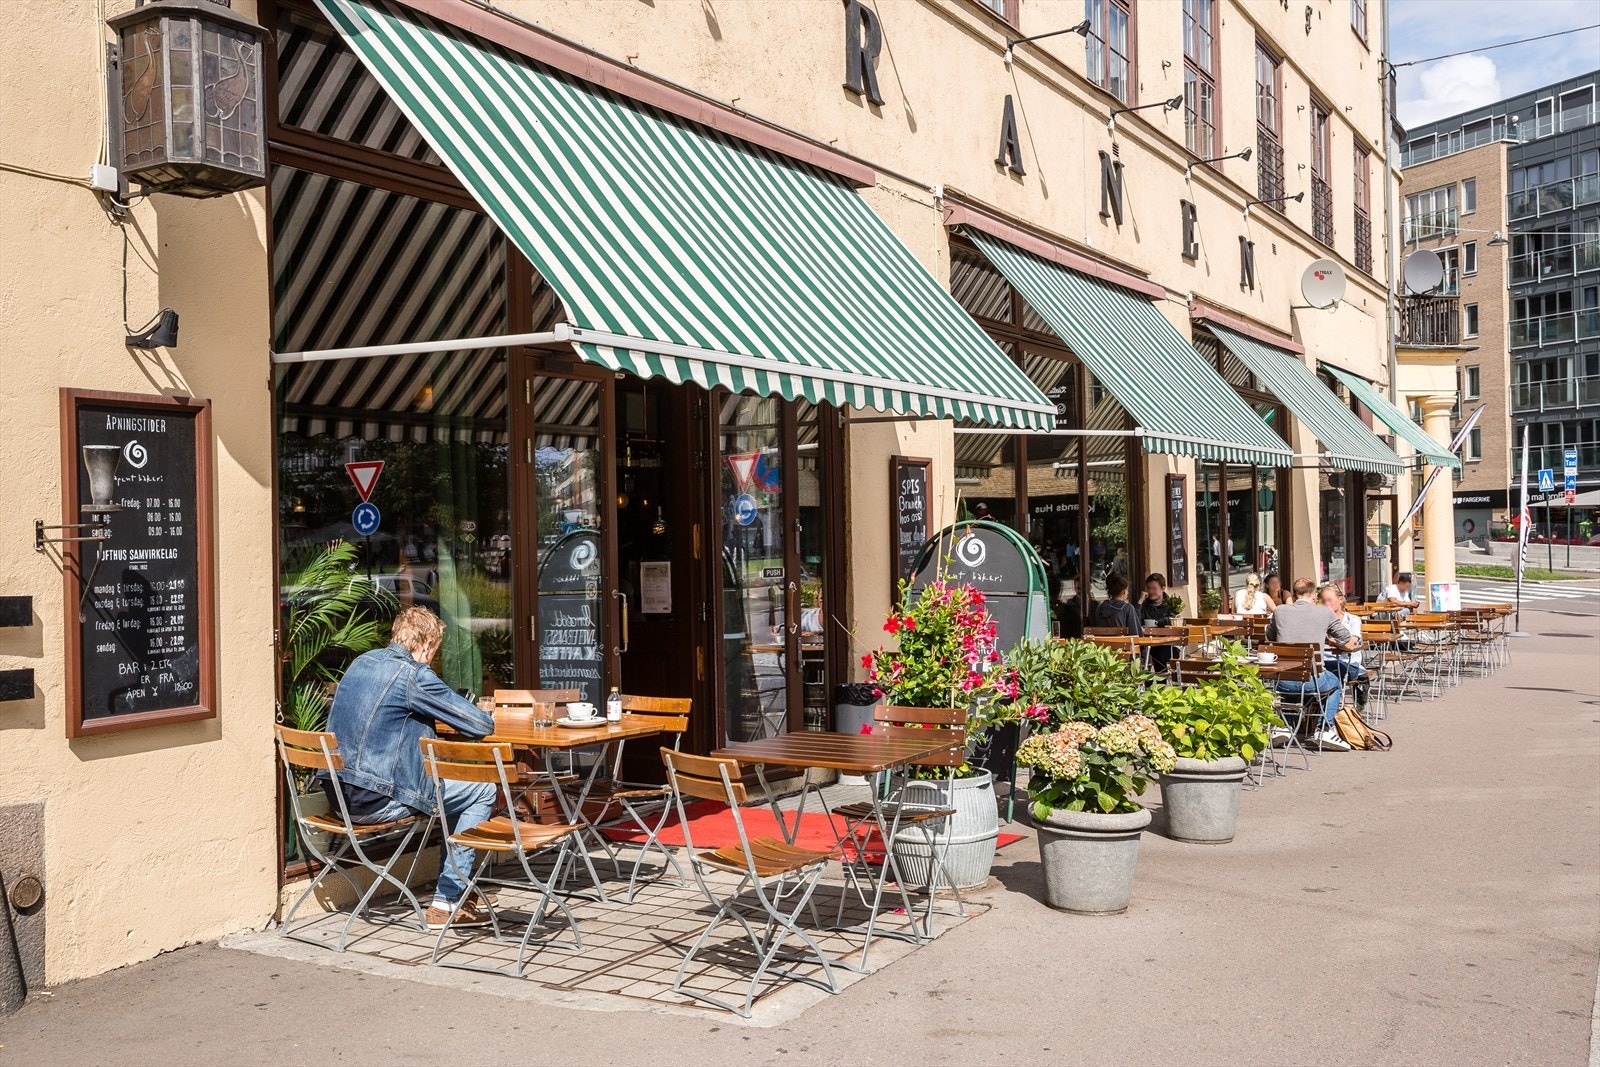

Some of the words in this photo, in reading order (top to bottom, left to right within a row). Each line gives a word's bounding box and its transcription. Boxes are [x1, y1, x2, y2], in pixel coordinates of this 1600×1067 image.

[106, 414, 166, 432] ÅPNINGSTIDER
[902, 479, 920, 495] SPIS
[130, 548, 178, 560] SAMVIRKELAG
[972, 572, 1003, 582] bakeri
[94, 584, 114, 596] mandag
[96, 620, 114, 632] fredag
[119, 662, 140, 674] BAR
[151, 660, 158, 670] 2
[159, 659, 172, 669] ETG
[140, 675, 150, 684] ER
[160, 672, 174, 684] FRA
[126, 688, 146, 700] ÅPEN
